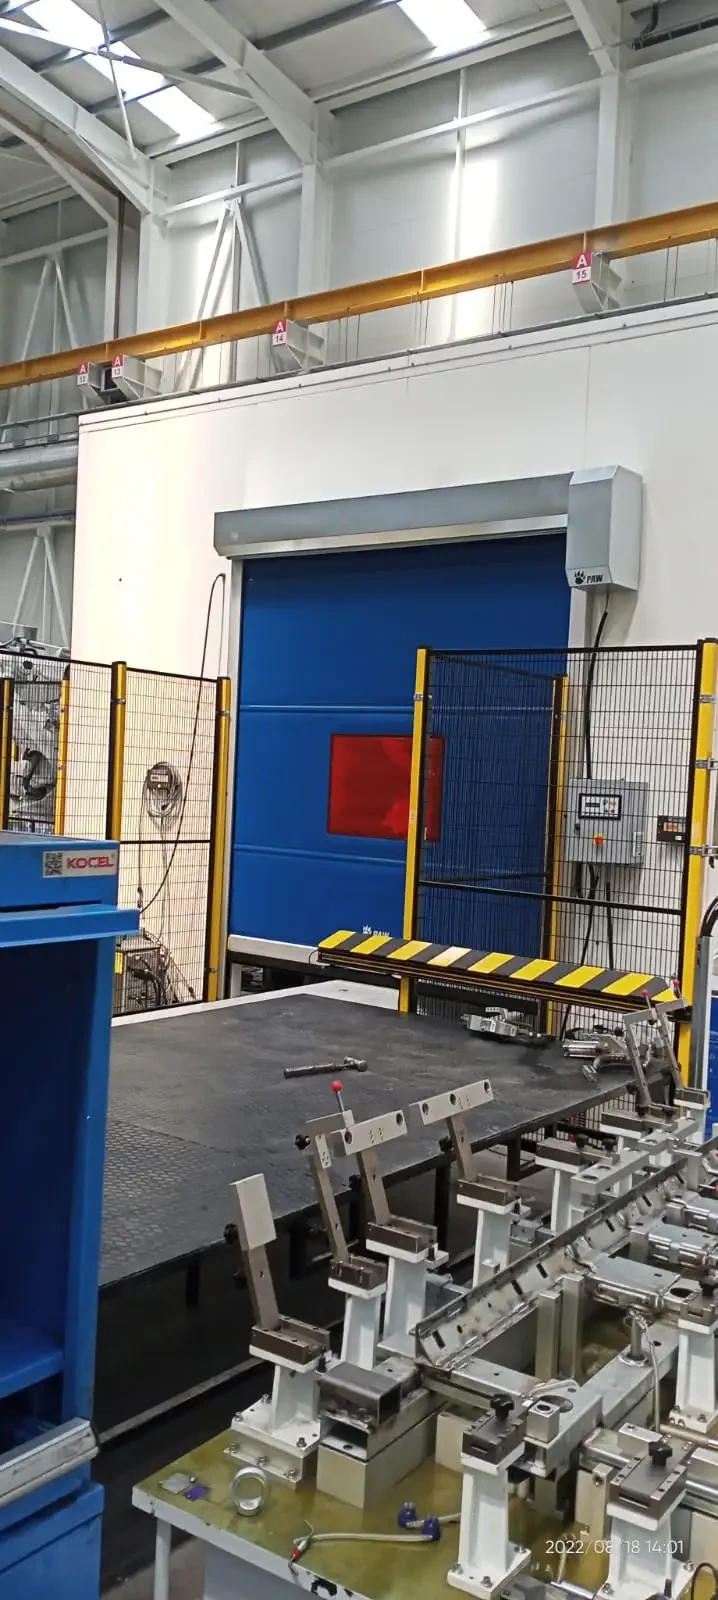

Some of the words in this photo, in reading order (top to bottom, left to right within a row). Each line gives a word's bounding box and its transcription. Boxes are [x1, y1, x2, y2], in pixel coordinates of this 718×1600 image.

[576, 254, 588, 268] A
[576, 270, 587, 280] 15
[275, 321, 284, 333] A
[275, 334, 284, 343] 14
[114, 355, 121, 366] A
[79, 364, 86, 373] A
[586, 573, 604, 584] PAW
[66, 856, 114, 869] KOCEL
